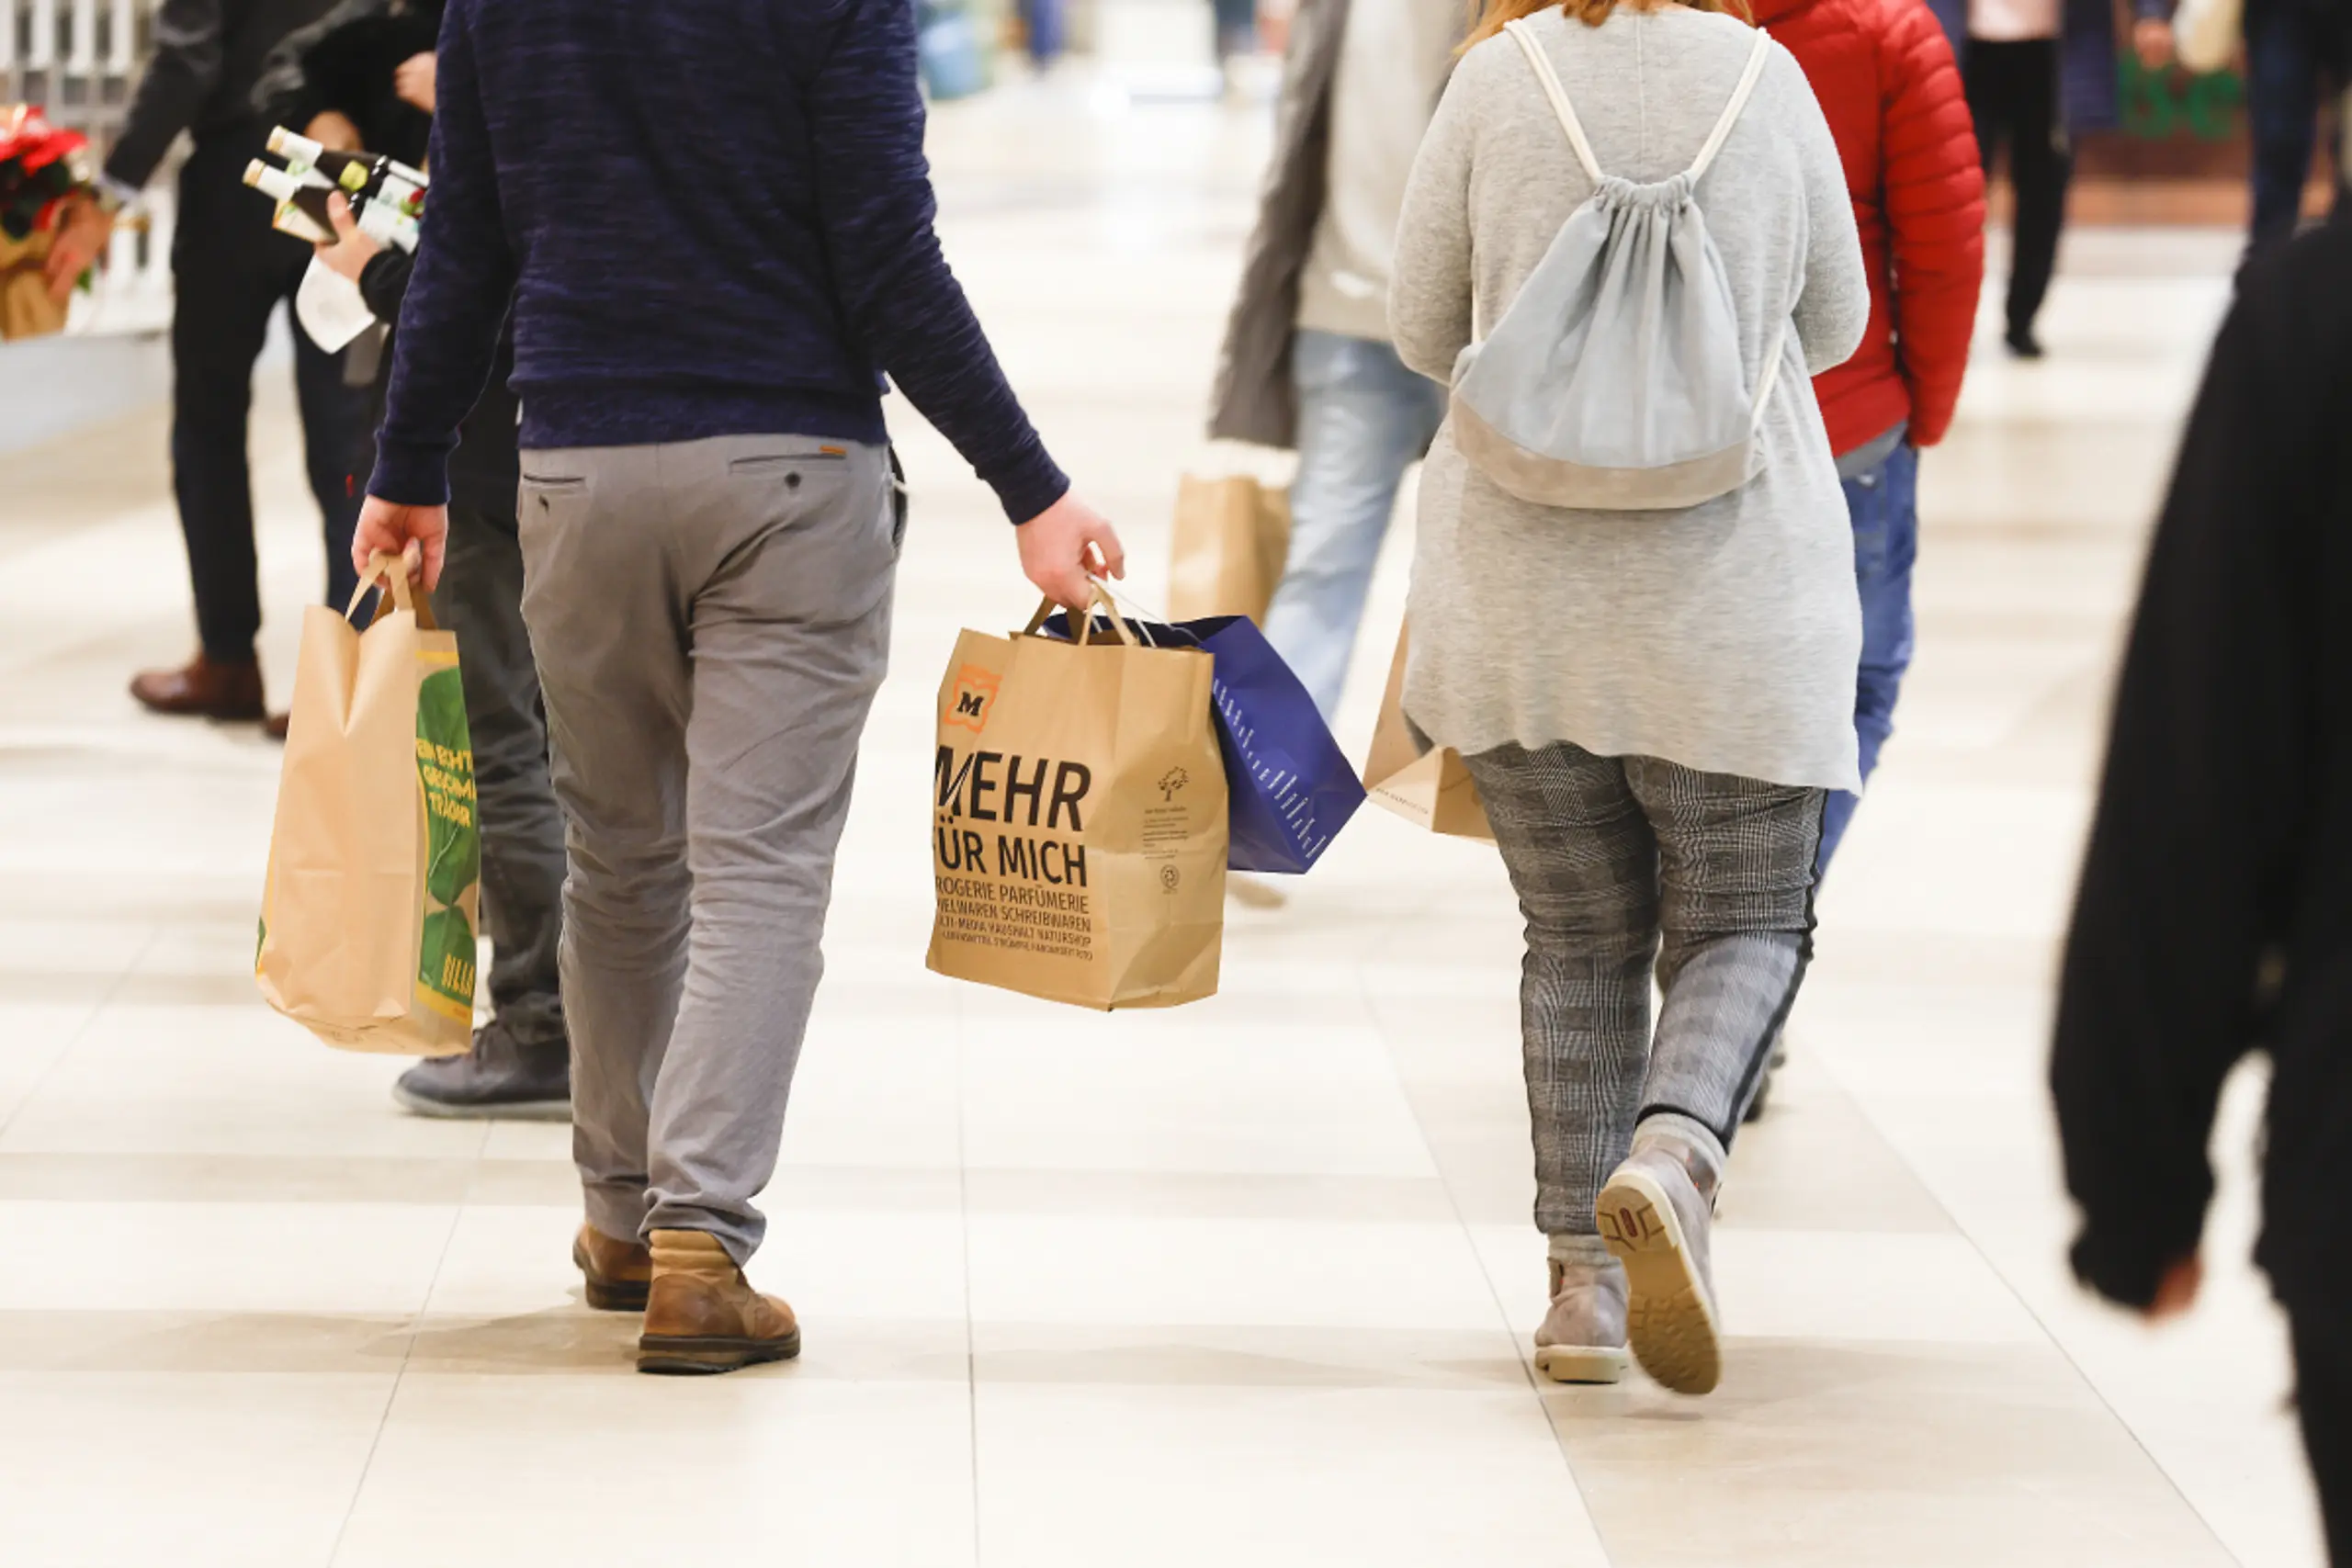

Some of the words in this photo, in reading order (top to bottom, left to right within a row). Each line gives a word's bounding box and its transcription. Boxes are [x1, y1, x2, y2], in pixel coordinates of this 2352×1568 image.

[956, 691, 984, 716] M
[935, 745, 1091, 831] MEHR
[934, 815, 988, 874] ÜR
[998, 834, 1087, 887] MICH
[935, 875, 997, 901] ROGERIE
[999, 884, 1091, 915] PARFÜMERIE
[937, 897, 998, 919] IELWAREN
[1001, 906, 1091, 933] SCHREIBWAREN
